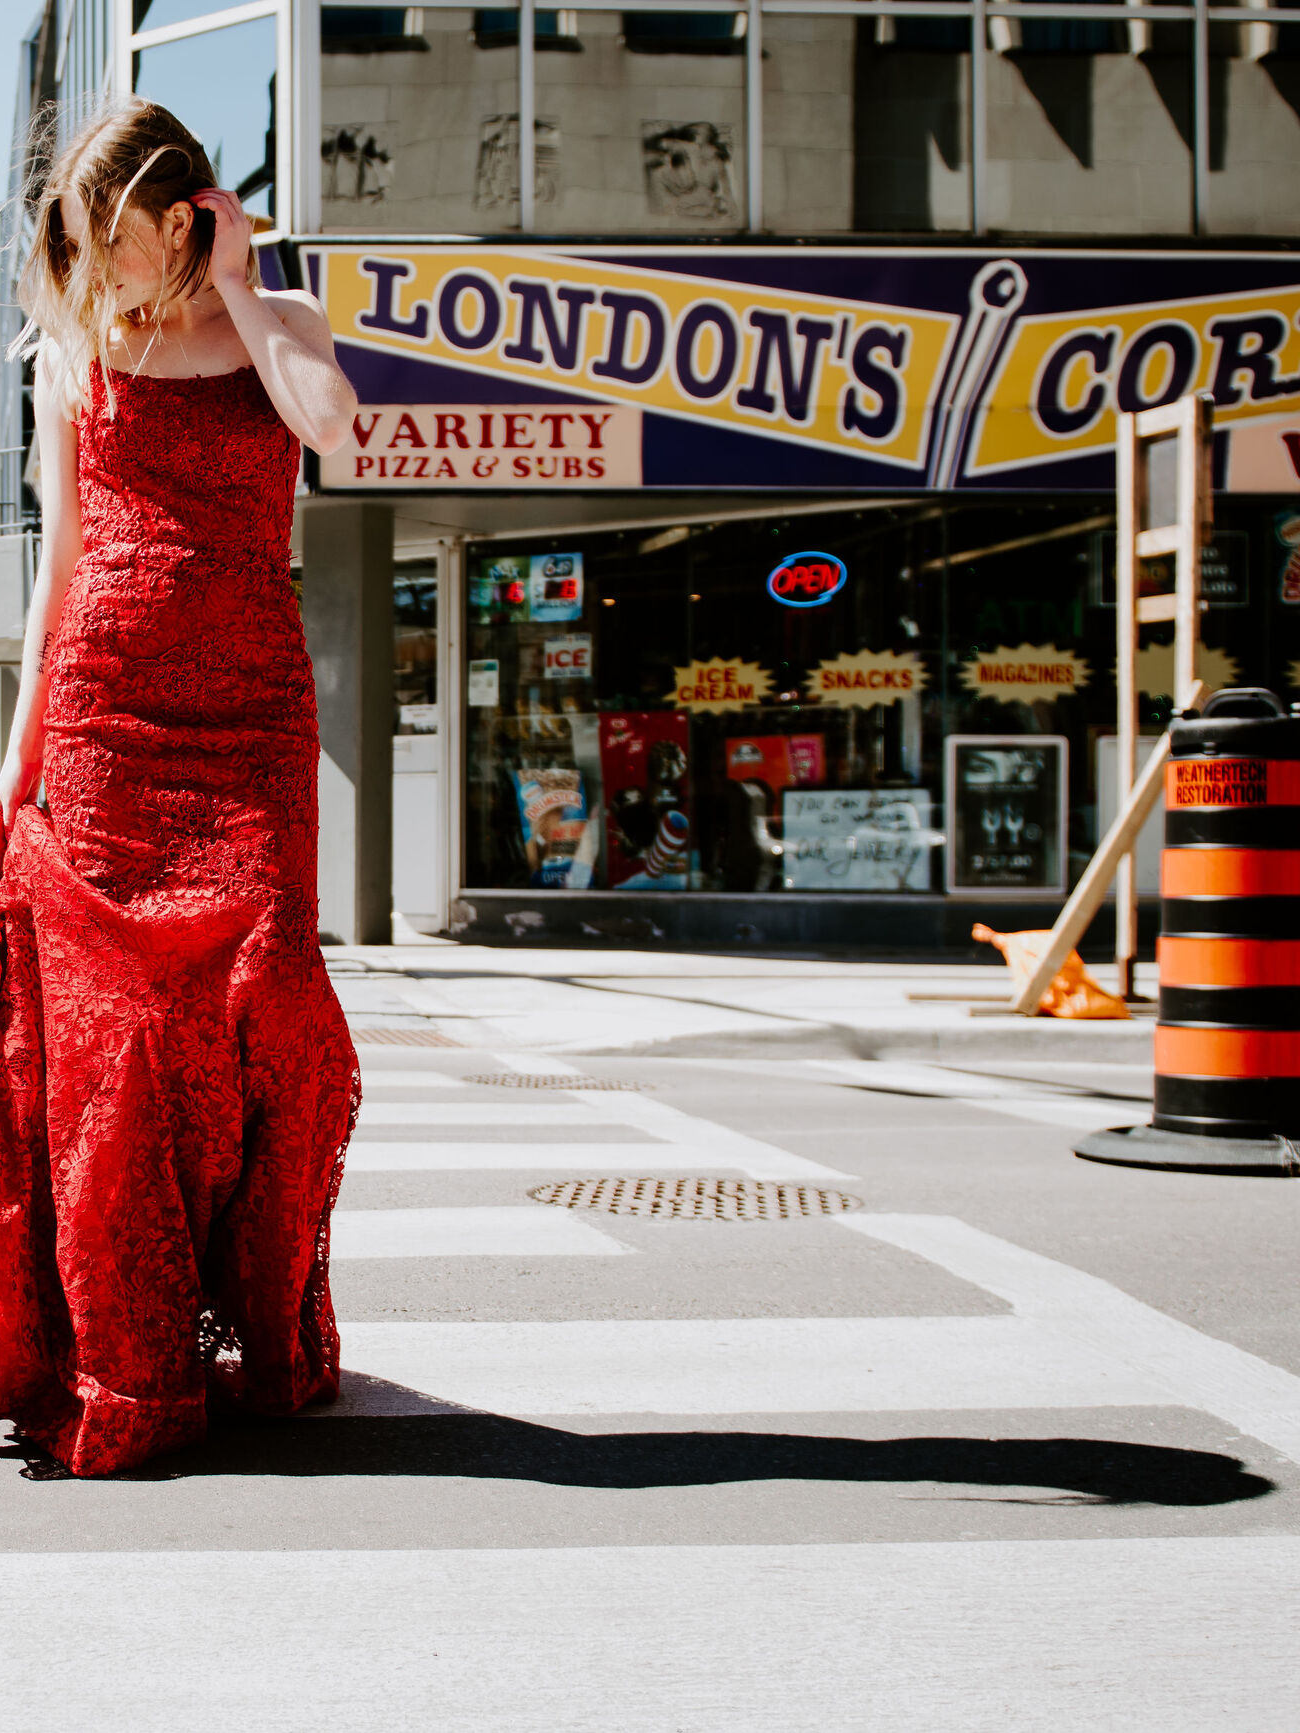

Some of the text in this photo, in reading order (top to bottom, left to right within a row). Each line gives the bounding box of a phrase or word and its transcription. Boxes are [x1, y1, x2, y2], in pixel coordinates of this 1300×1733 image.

[359, 258, 1300, 439] LONDON'S COR
[353, 412, 614, 450] VARIETY
[354, 455, 607, 479] PIZZA & SUBS
[771, 563, 841, 595] OPEN
[546, 647, 589, 668] ICE
[696, 666, 738, 684] ICE
[820, 669, 913, 690] SNACKS
[978, 662, 1075, 685] MAGAZINES
[677, 683, 755, 702] CREAM
[1176, 761, 1267, 783] WEATHERTECH
[1176, 782, 1267, 804] RESTORATION
